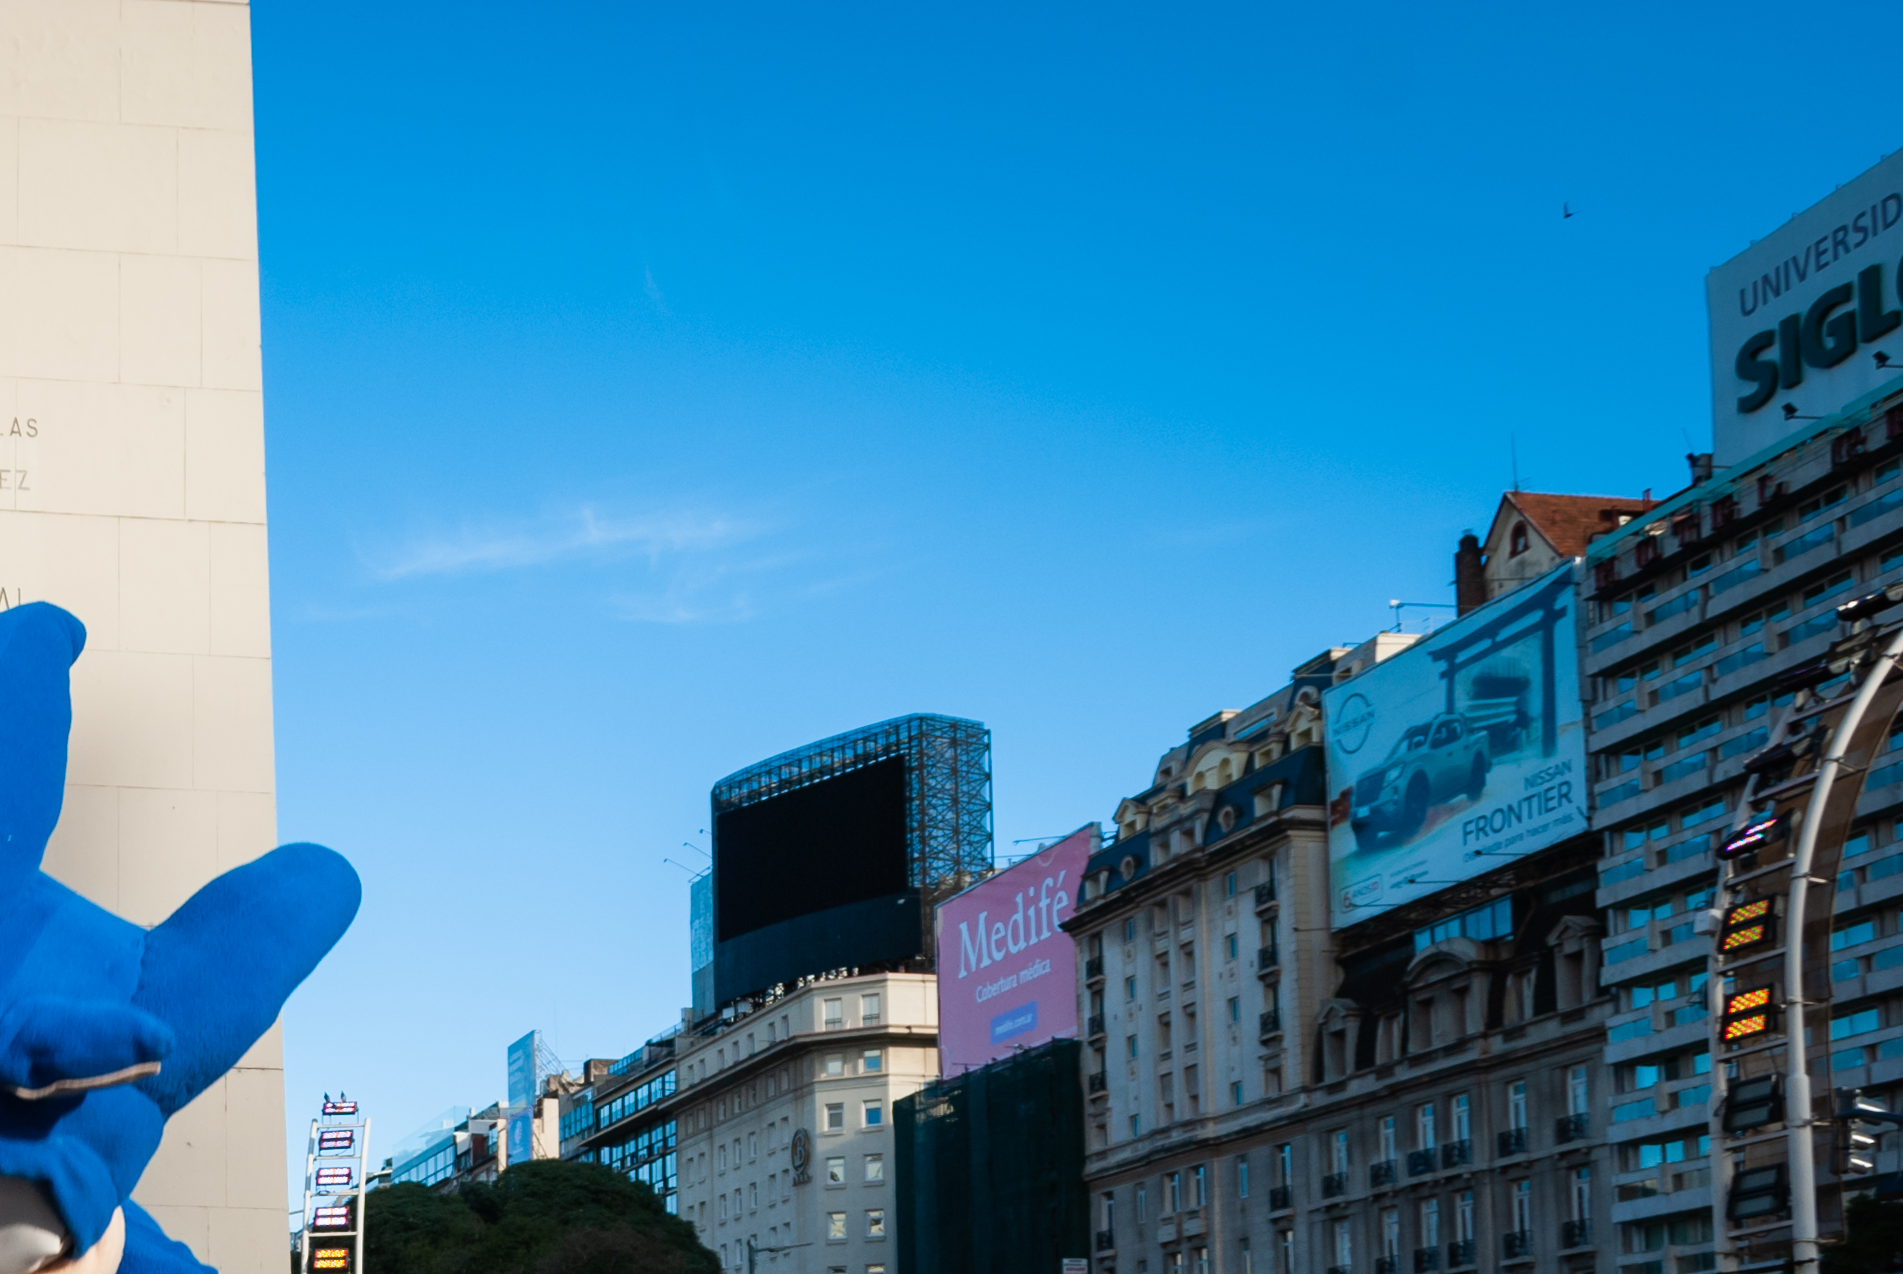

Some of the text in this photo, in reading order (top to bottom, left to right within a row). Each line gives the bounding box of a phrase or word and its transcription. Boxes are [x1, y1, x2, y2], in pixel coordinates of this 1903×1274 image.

[1734, 251, 1903, 416] SIGL
[1523, 758, 1572, 792] NISSAN
[1462, 779, 1574, 847] FRONTIER
[956, 869, 1070, 980] Medifé
[975, 958, 1052, 1003] Cobertura médica
